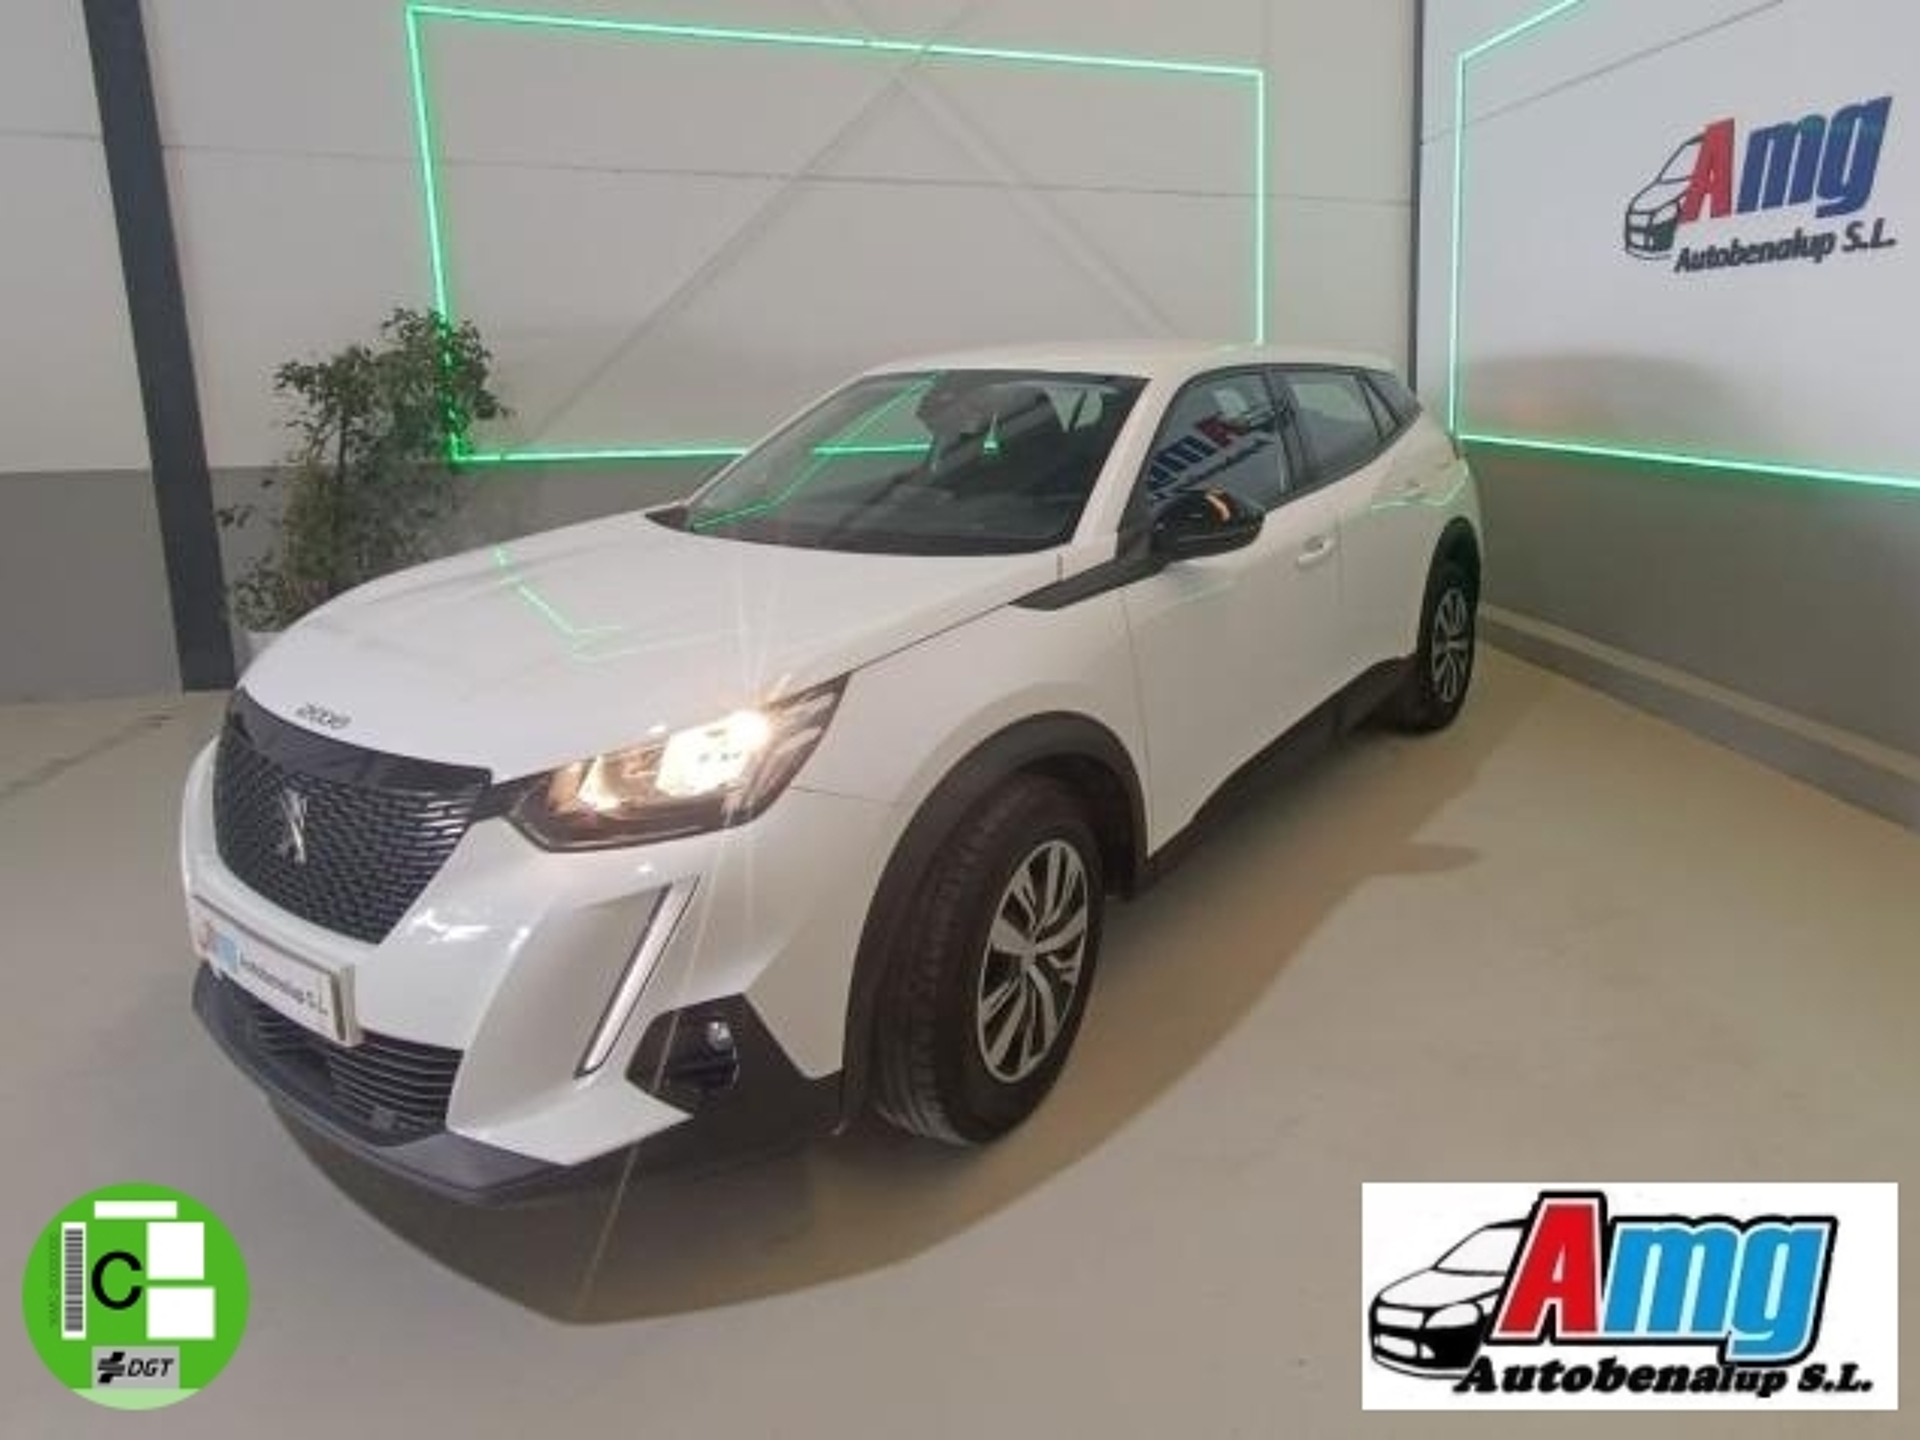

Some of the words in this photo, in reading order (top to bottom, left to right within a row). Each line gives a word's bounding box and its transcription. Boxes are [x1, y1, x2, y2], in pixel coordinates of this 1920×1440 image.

[1676, 95, 1893, 225] Amg
[1674, 227, 1837, 273] Autobenalup
[1841, 217, 1897, 252] S.L.
